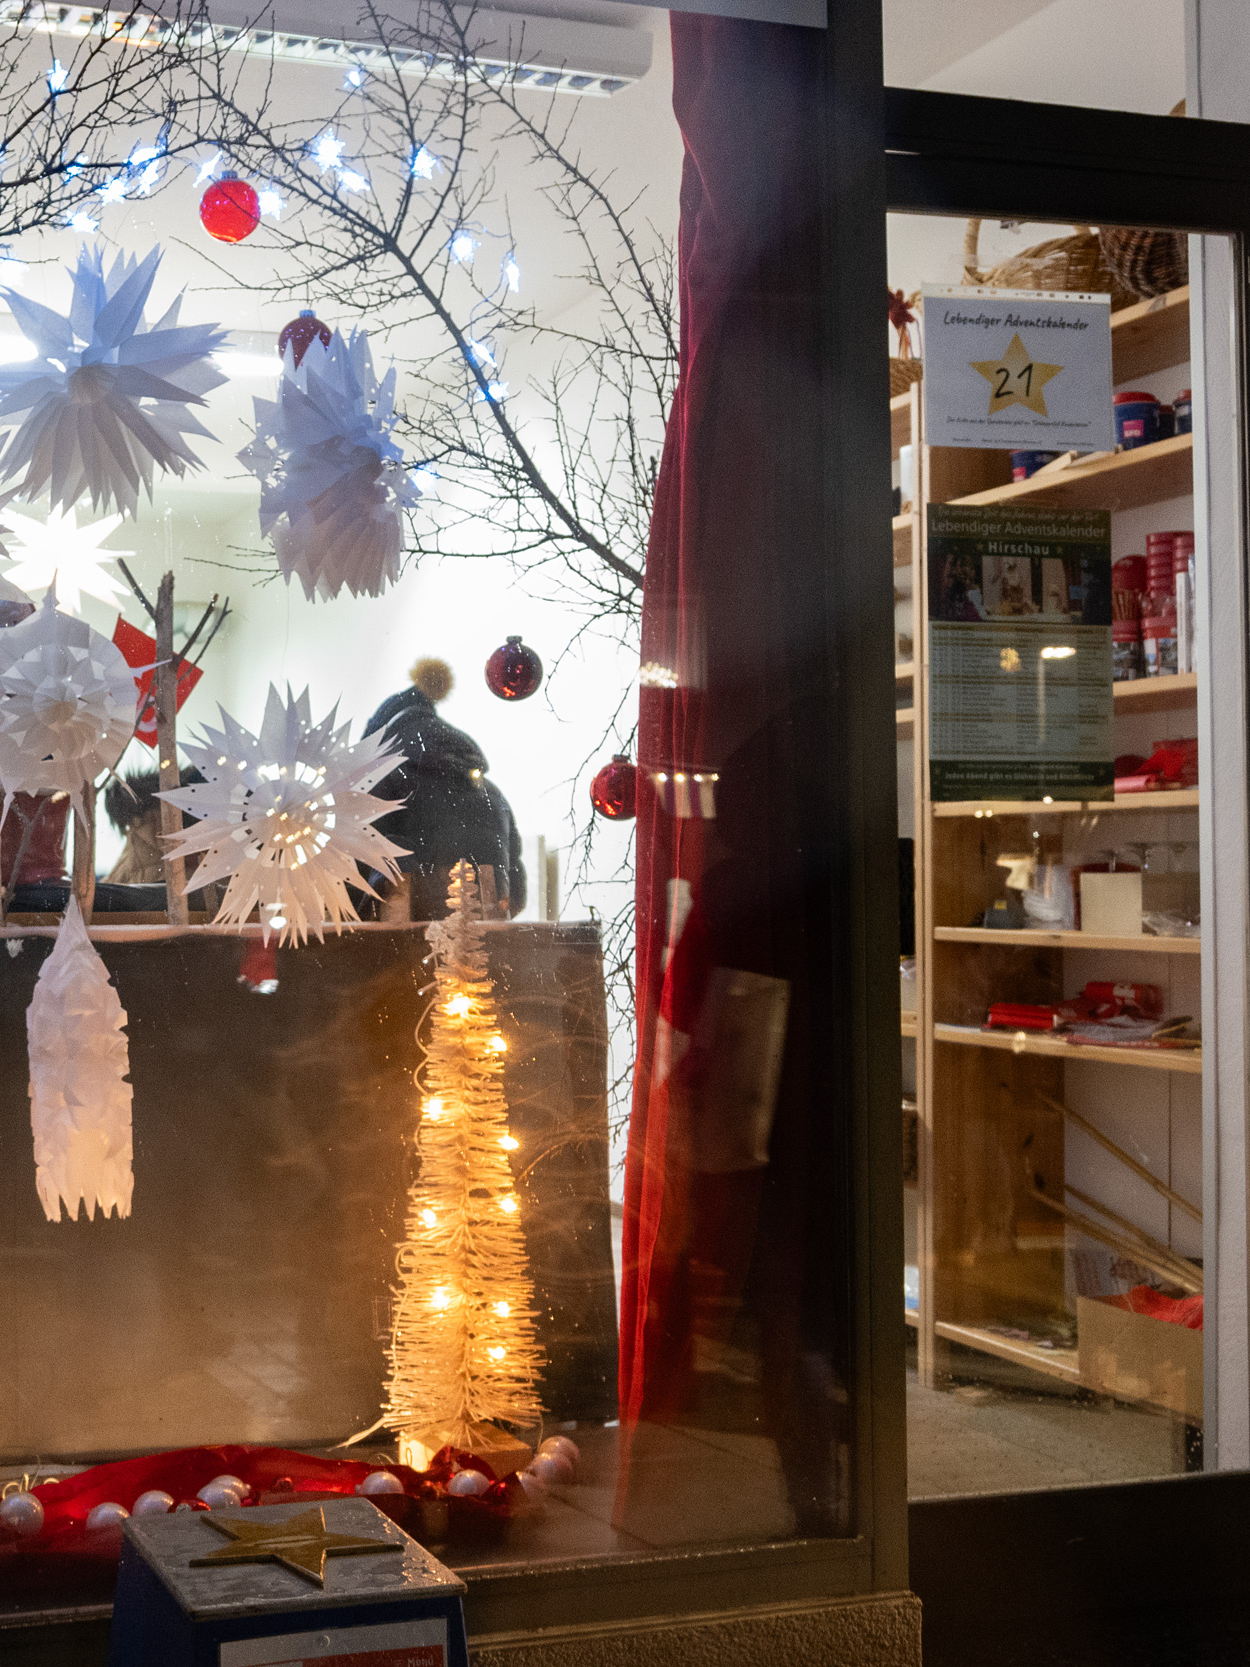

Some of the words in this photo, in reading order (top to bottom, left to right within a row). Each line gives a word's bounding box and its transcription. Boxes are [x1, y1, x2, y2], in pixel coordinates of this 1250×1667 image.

[943, 311, 1002, 330] Lebendiger
[1004, 313, 1090, 331] Adventskalender
[994, 363, 1033, 399] 21
[931, 519, 1002, 536] Lebendiger
[1004, 521, 1106, 538] Adventskalender
[988, 541, 1050, 555] Hirschau
